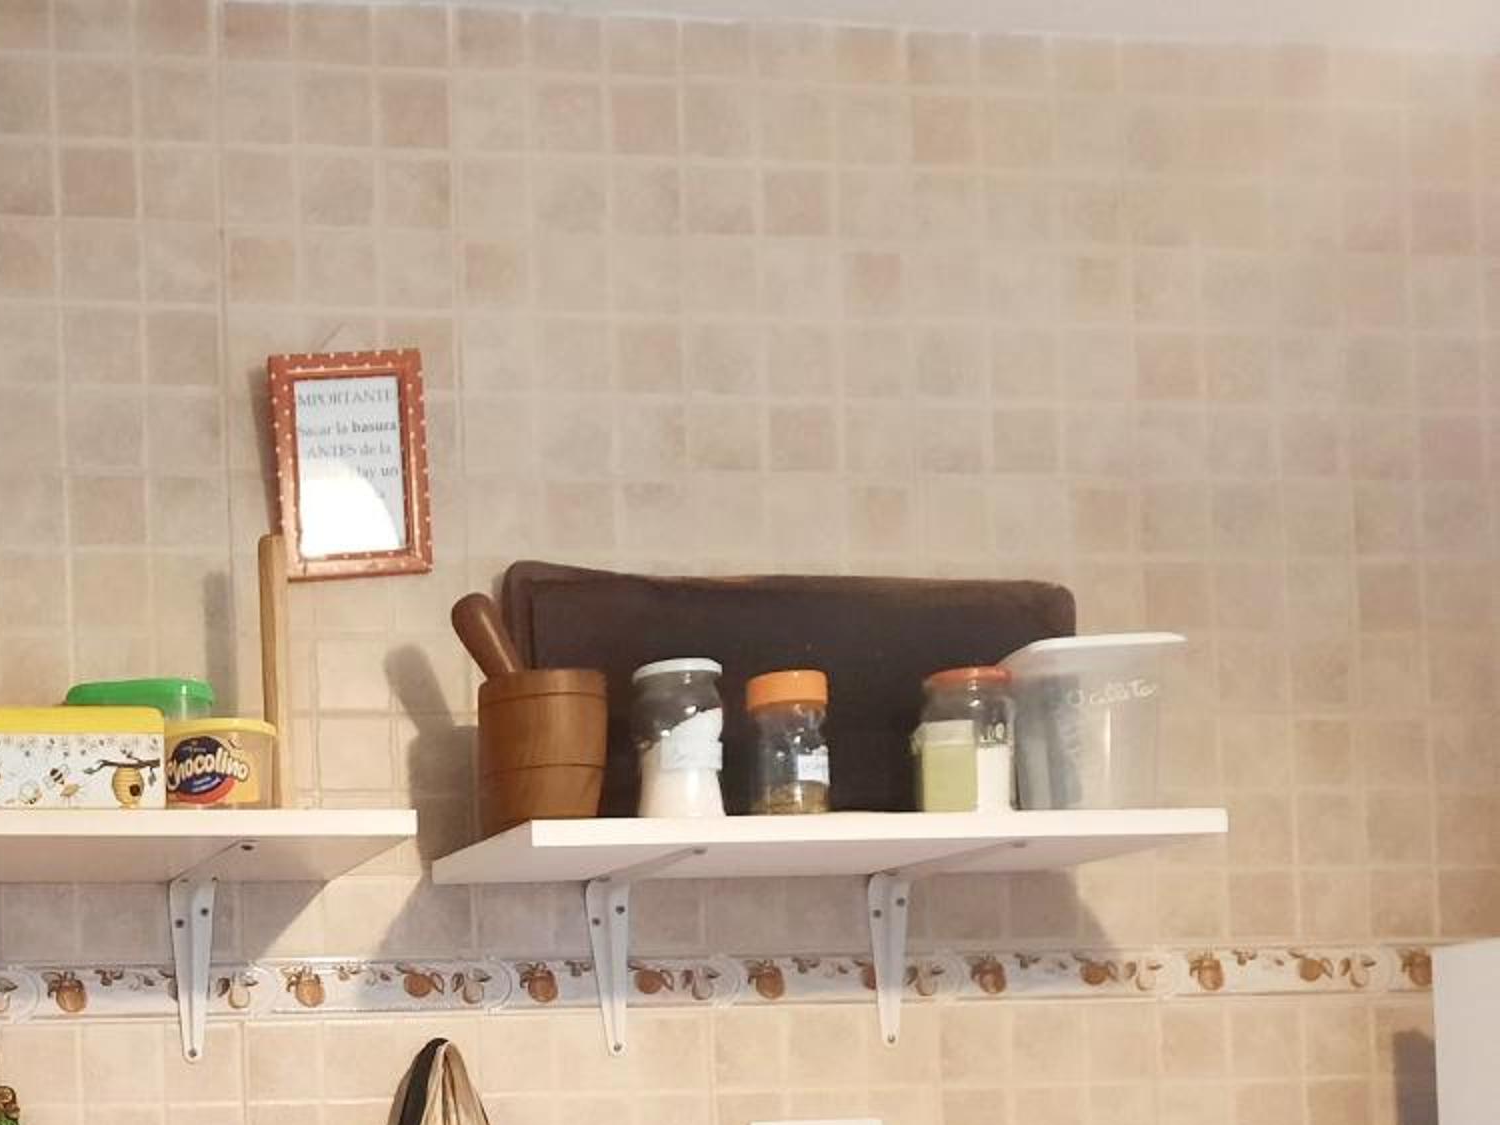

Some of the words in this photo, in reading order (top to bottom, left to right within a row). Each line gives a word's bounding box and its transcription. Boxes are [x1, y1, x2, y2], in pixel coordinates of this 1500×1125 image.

[351, 418, 397, 432] basura
[309, 445, 357, 458] ANTES
[360, 441, 376, 455] de
